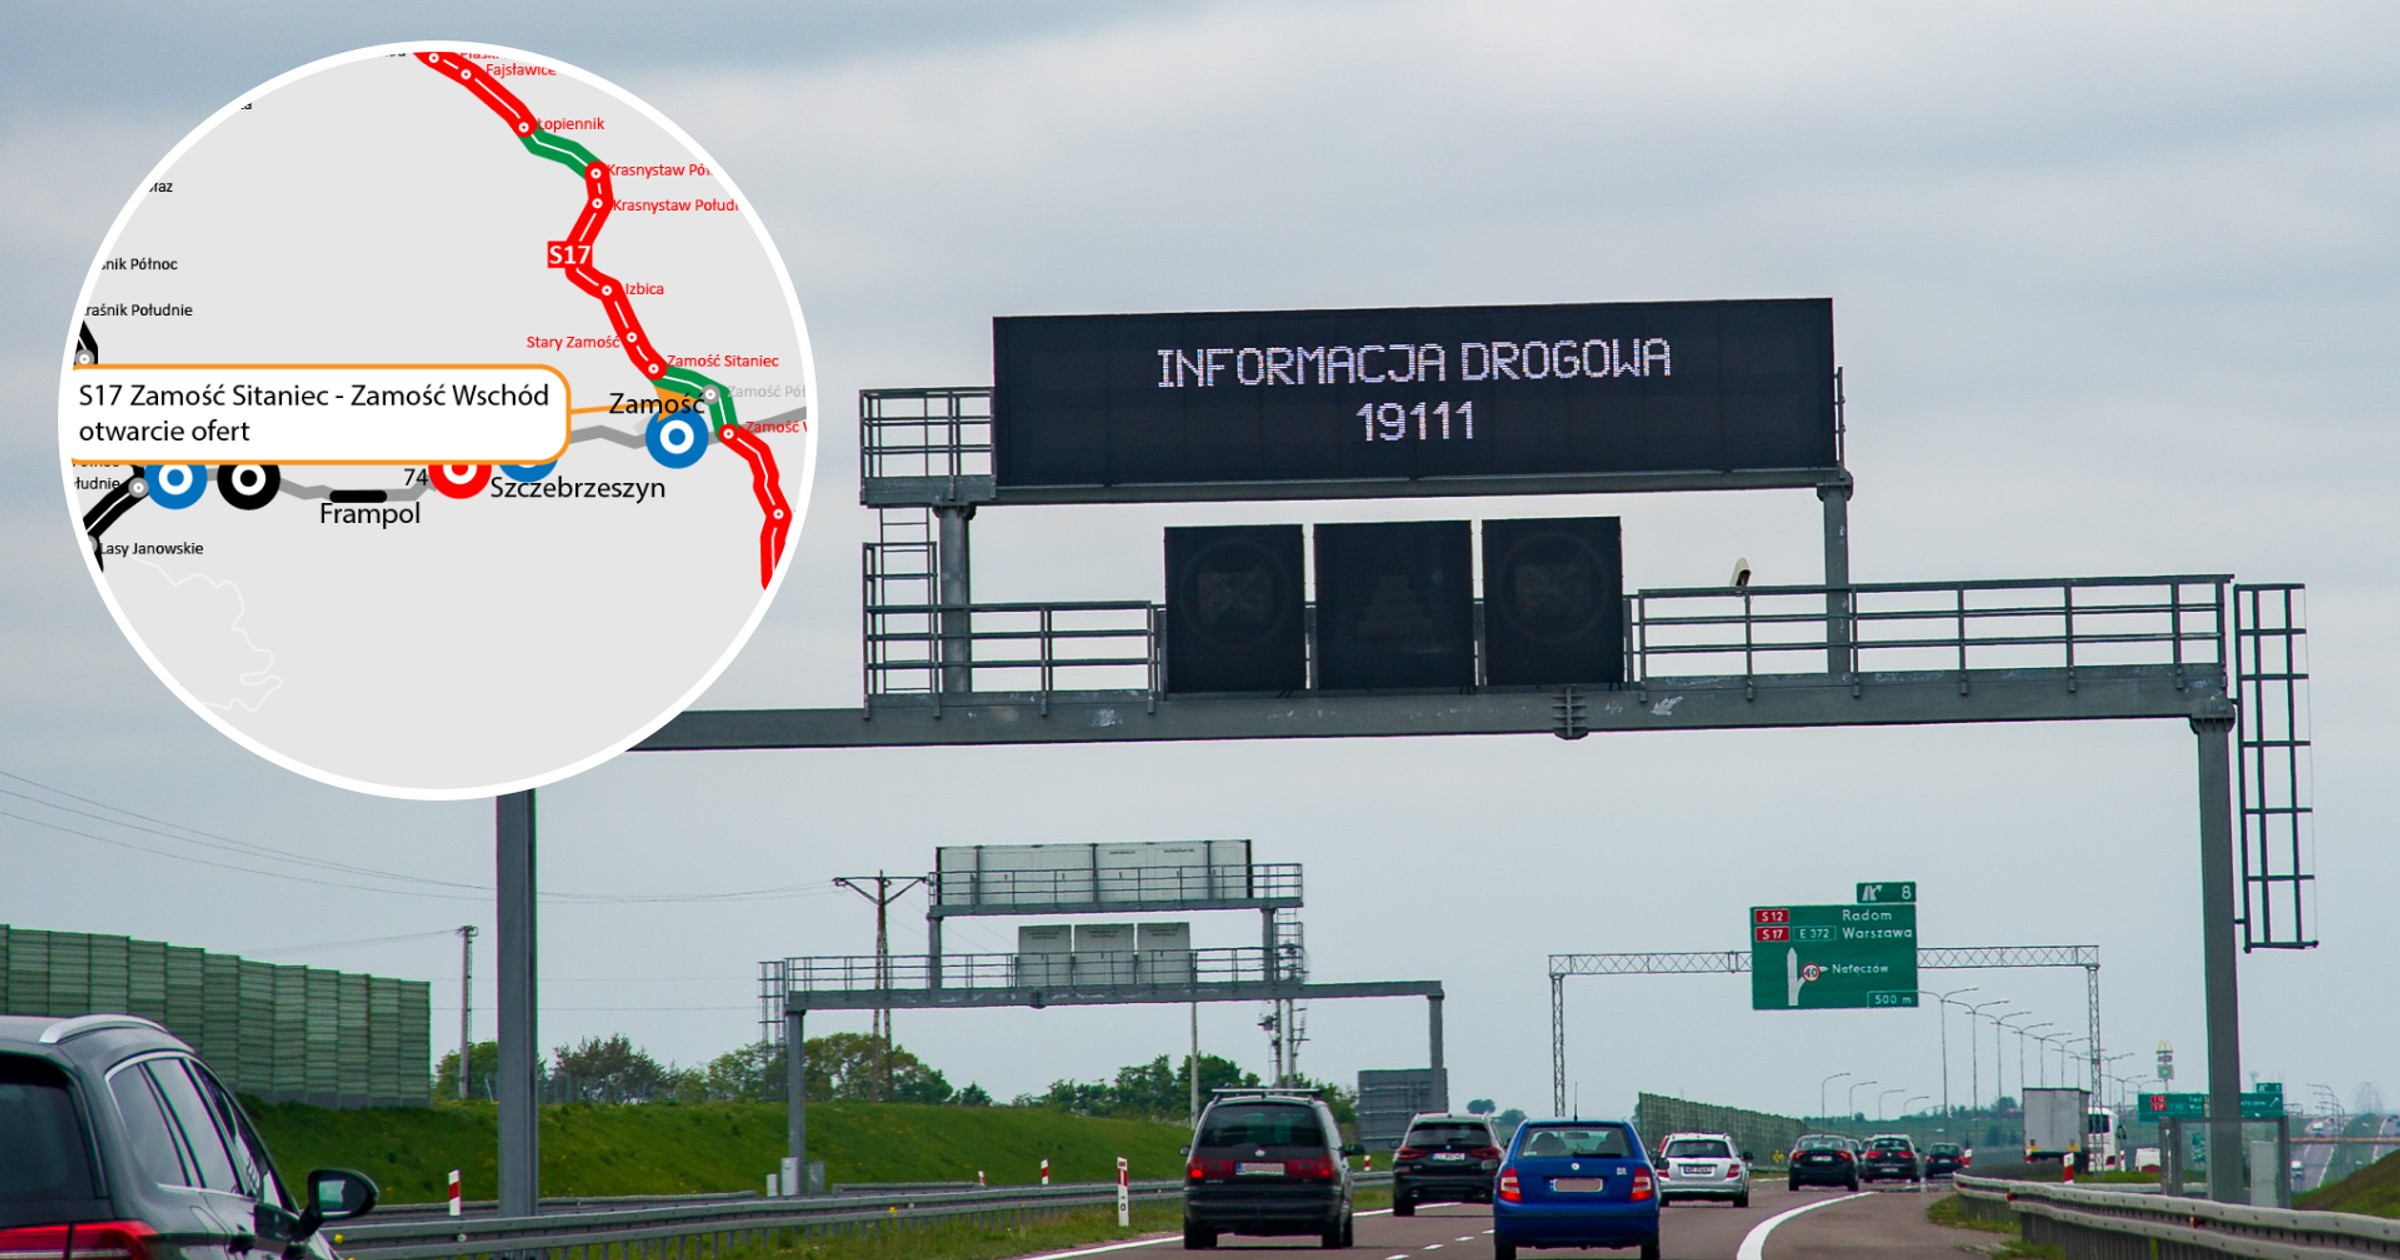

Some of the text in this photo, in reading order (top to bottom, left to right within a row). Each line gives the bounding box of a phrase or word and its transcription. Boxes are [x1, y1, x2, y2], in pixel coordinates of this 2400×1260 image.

[1157, 337, 1672, 388] INFORMACJA DROGOWA
[1356, 400, 1473, 442] 19111
[1901, 885, 1912, 900] 8
[1842, 909, 1893, 922] Radom
[1810, 928, 1830, 939] 372
[1842, 927, 1913, 940] Warszawa
[1804, 966, 1819, 978] 40
[1832, 963, 1889, 976] Nałęczów
[1875, 994, 1912, 1005] 500 m
